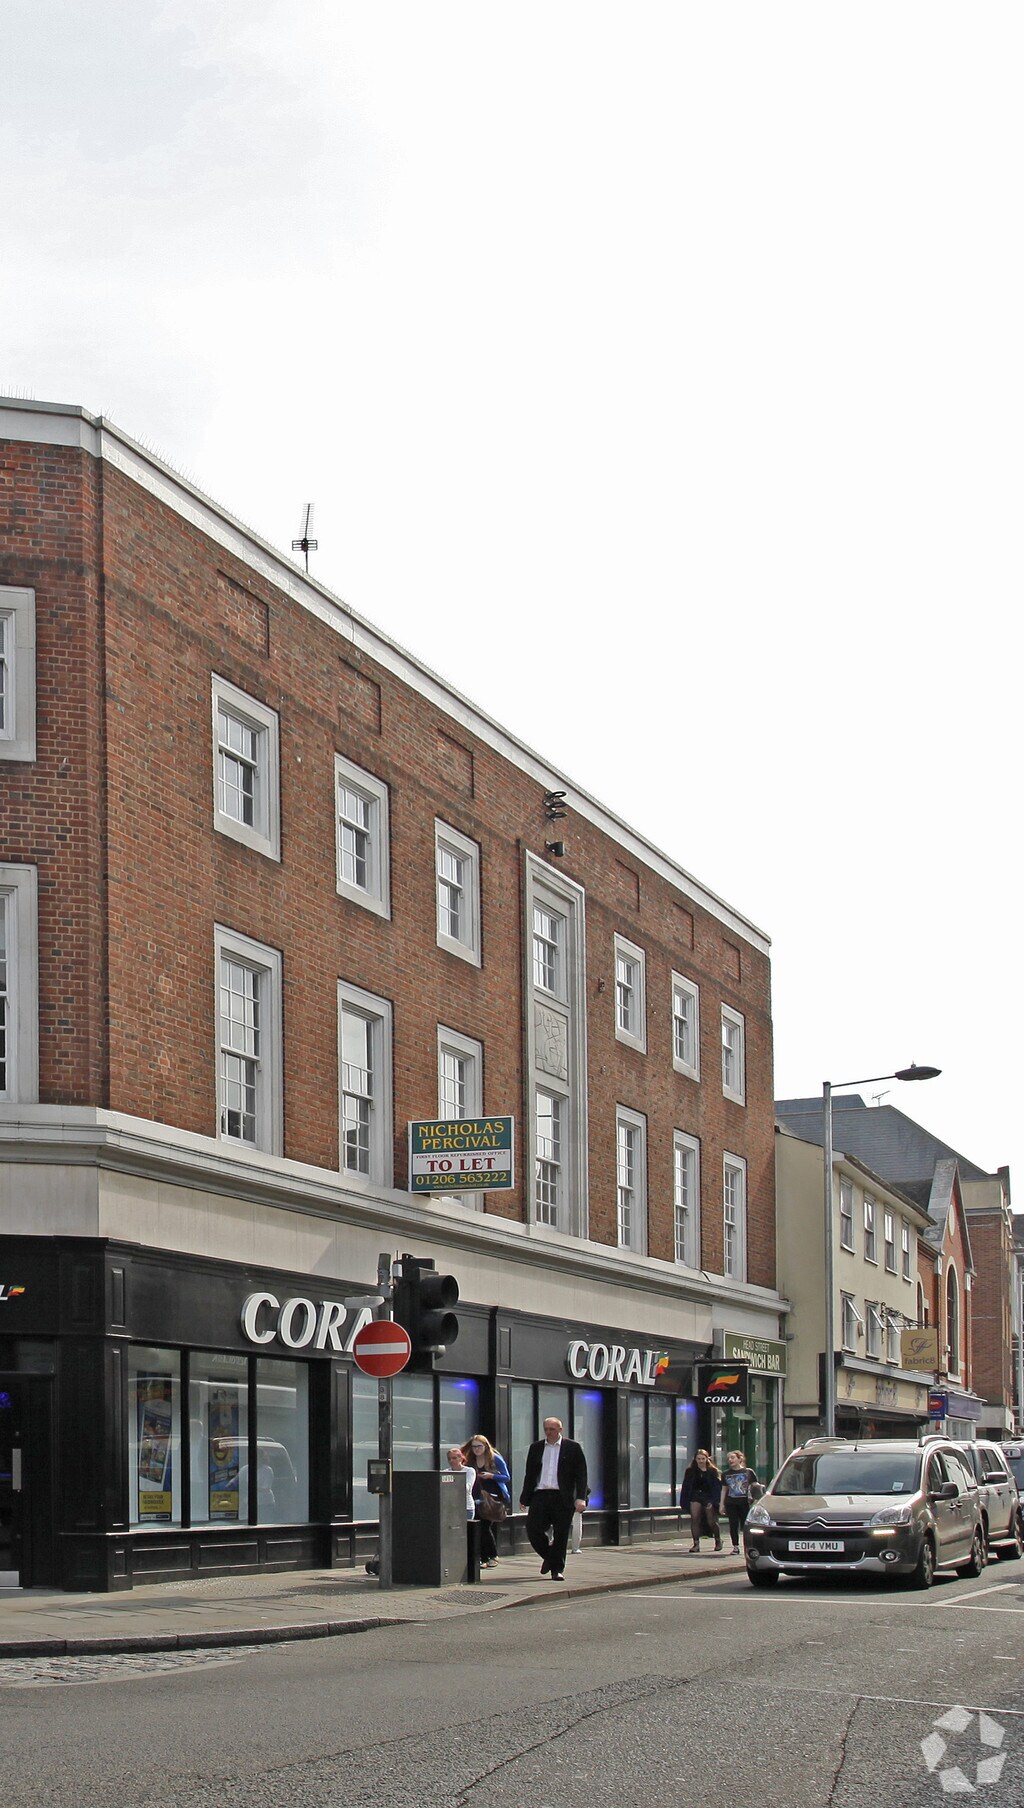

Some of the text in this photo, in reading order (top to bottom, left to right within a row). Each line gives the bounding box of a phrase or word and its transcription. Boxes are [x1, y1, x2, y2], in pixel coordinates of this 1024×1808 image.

[419, 1121, 505, 1137] NICHOLAS
[422, 1135, 501, 1150] PERCIVAL
[426, 1157, 496, 1173] TO LET
[416, 1171, 508, 1185] 01206 563222
[742, 1339, 770, 1353] HEAD STREET
[567, 1339, 658, 1386] CORAL
[767, 1354, 780, 1370] BAR
[905, 1356, 936, 1365] fabric8
[703, 1395, 742, 1403] CORAL
[794, 1541, 839, 1550] EO14 VMU
